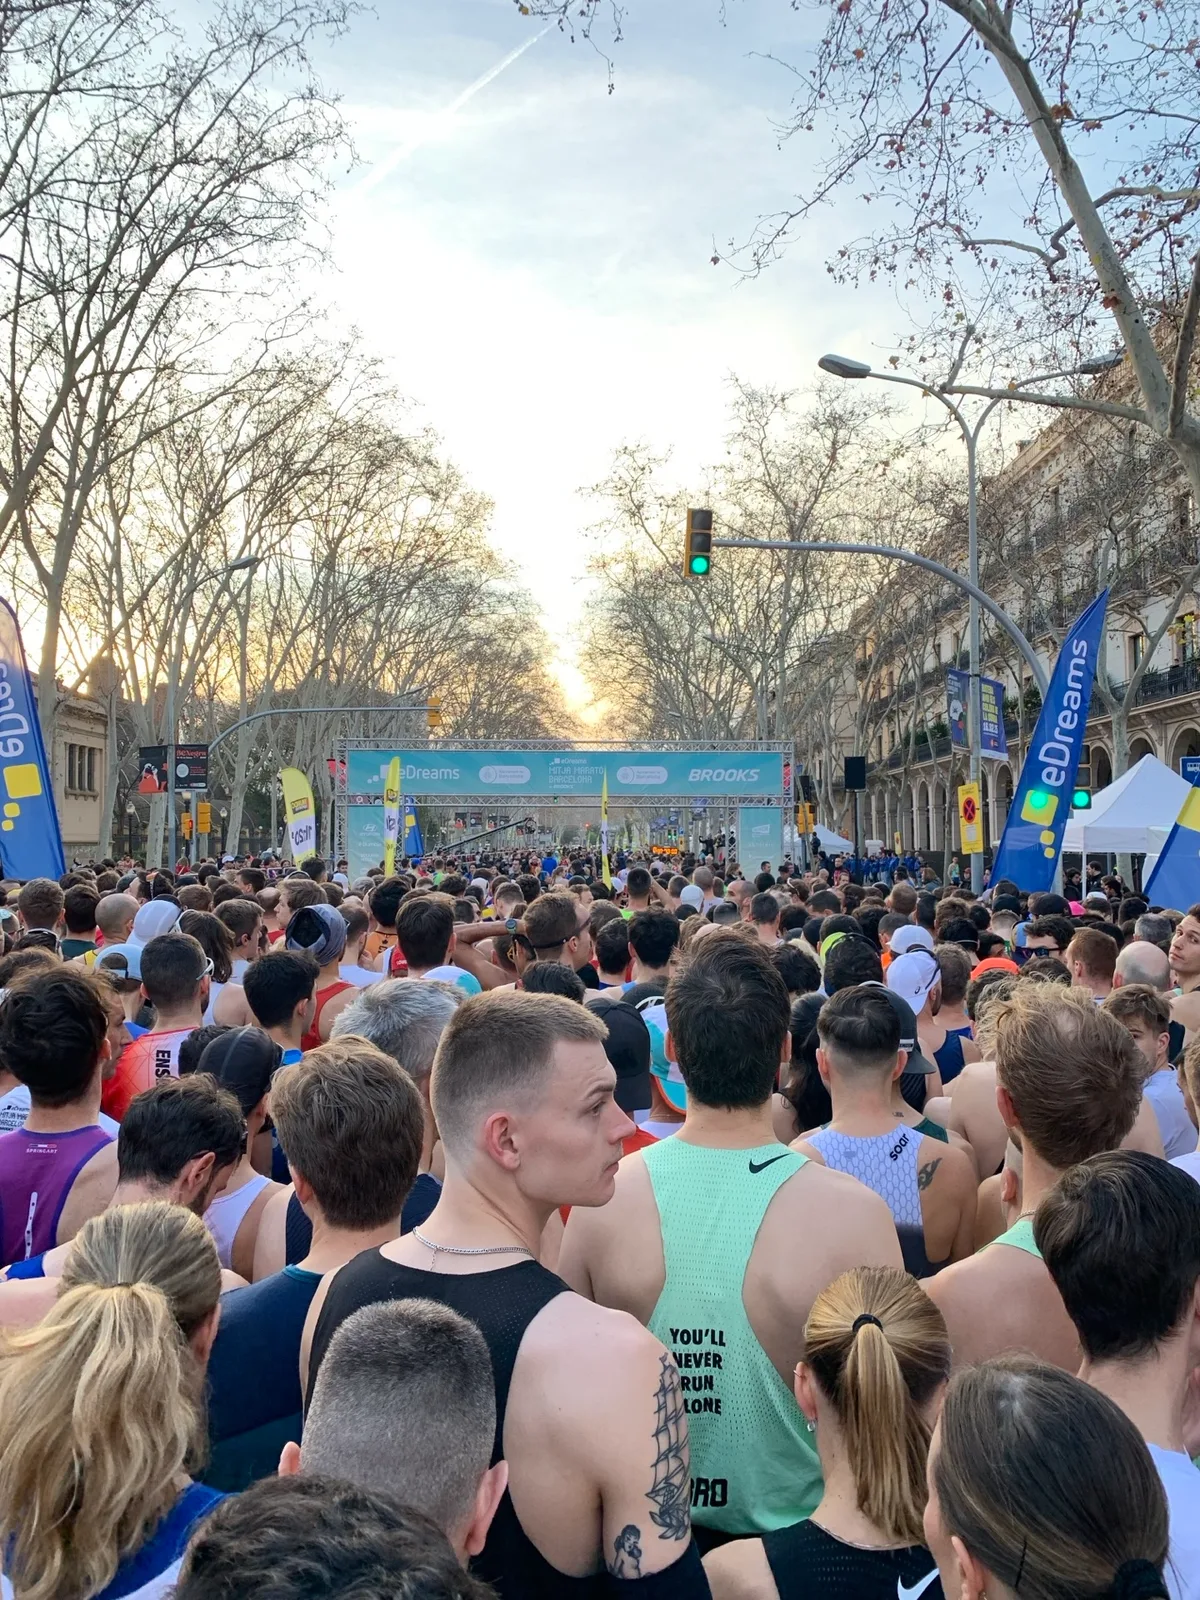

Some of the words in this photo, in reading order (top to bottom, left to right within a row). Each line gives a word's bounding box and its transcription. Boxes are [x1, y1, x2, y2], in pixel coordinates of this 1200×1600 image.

[1038, 639, 1087, 787] eDreams
[688, 769, 760, 781] BROOKS
[155, 1050, 171, 1086] ENS
[889, 1133, 910, 1161] soar
[669, 1328, 726, 1347] YOU'LL
[672, 1352, 723, 1370] NEVER
[681, 1375, 714, 1392] RUN
[683, 1397, 722, 1416] LONE
